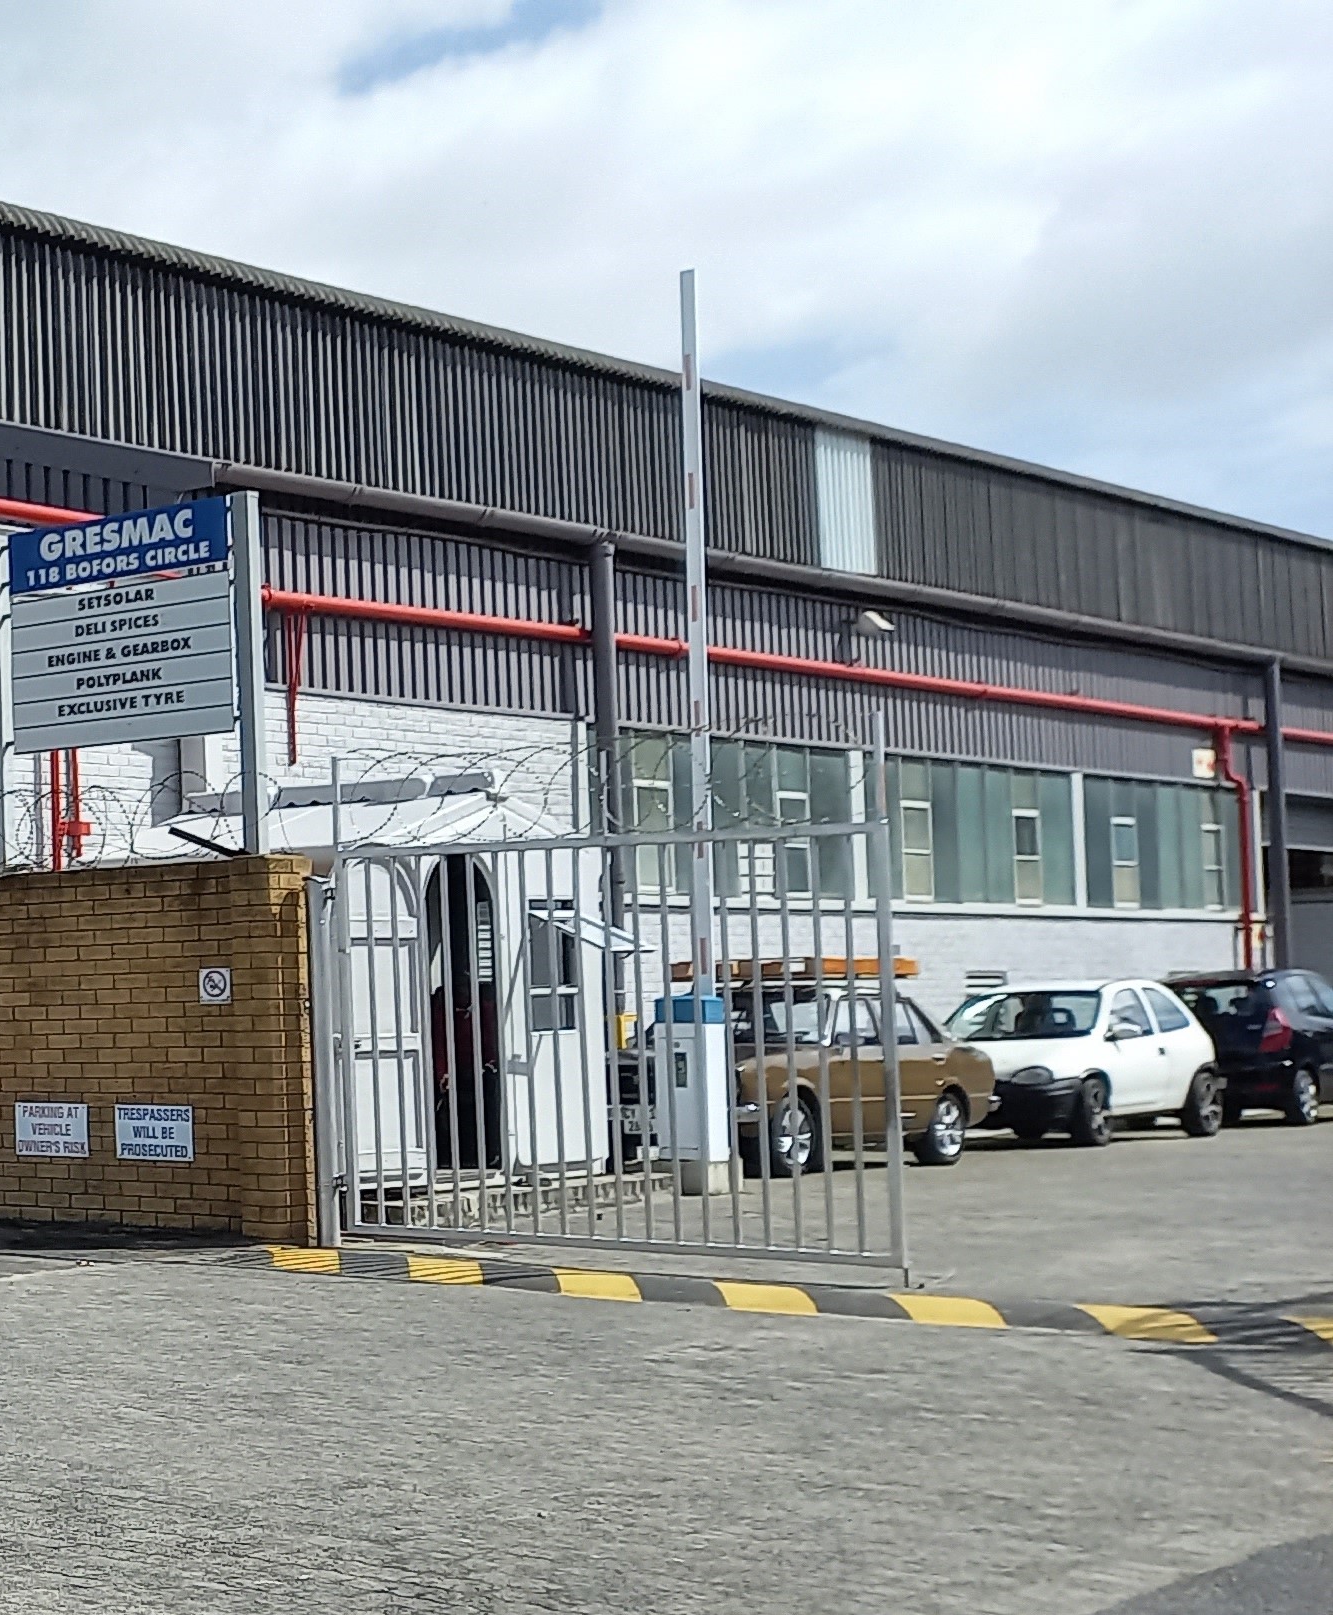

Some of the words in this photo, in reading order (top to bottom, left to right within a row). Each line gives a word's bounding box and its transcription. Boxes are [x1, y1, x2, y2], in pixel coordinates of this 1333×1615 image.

[39, 508, 195, 562] GRESMAC
[26, 569, 61, 587] 118
[65, 553, 140, 581] BOFORS
[145, 540, 211, 568] CIRCLE
[77, 588, 155, 612] SETSOLAR
[74, 622, 107, 638] DELI
[110, 614, 160, 633] SPICES
[47, 648, 101, 668] ENGINE
[105, 646, 117, 660] &
[120, 636, 192, 659] GEARBOX
[76, 667, 163, 691] POLYPLANK
[57, 696, 138, 718] EXCLUSIVE
[142, 690, 186, 708] TYRE
[22, 1105, 65, 1119] PARKING
[66, 1106, 80, 1119] AT
[117, 1107, 190, 1122] TRESPASSERS
[30, 1122, 72, 1137] VEHICLE
[132, 1125, 159, 1139] WILL
[161, 1126, 175, 1140] BE
[17, 1139, 61, 1154] OWNER'S
[62, 1141, 87, 1155] RISK
[119, 1142, 189, 1158] PROSECUTED
